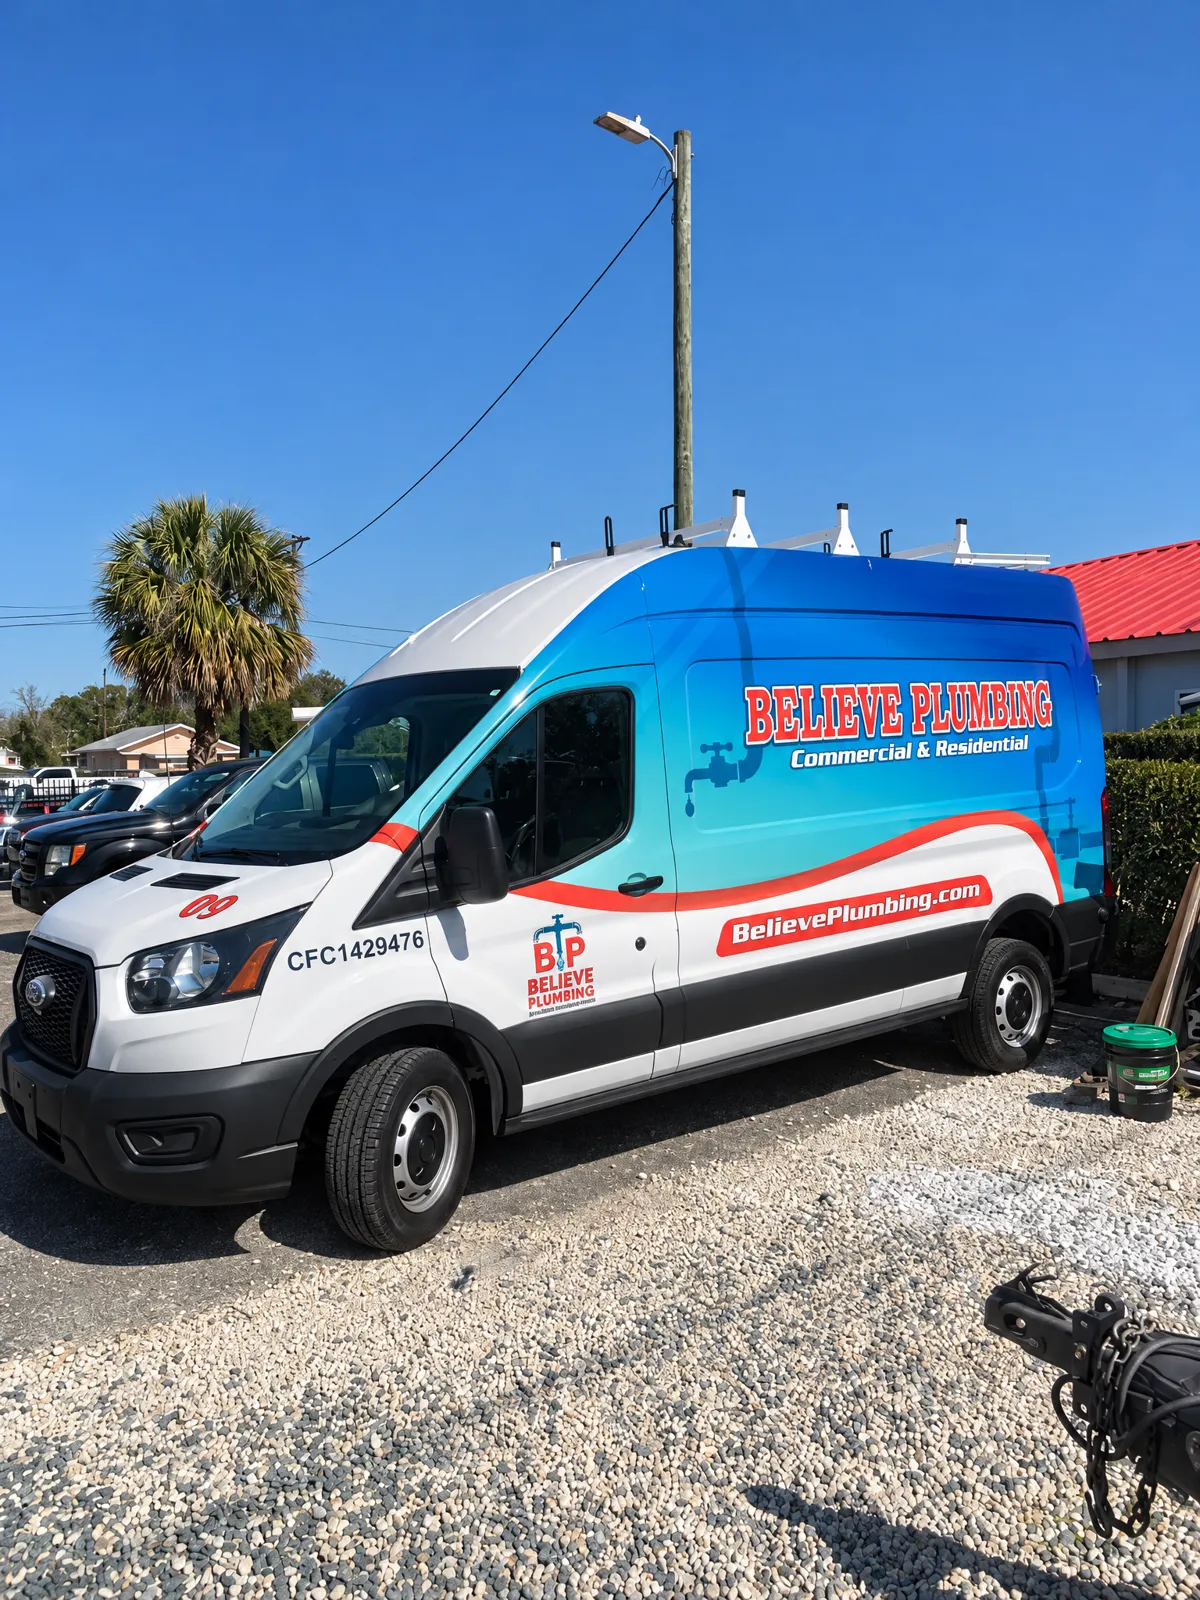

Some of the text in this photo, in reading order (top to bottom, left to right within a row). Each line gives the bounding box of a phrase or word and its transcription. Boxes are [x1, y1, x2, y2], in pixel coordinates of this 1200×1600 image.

[744, 680, 1053, 745] BELIEVE PLUMBING
[790, 734, 1029, 769] Commercial & Residential
[732, 882, 980, 944] BelievePlumbing.com
[287, 930, 425, 971] CFC1429476
[527, 967, 594, 996] BELIEVE
[528, 985, 595, 1010] PLUMBING
